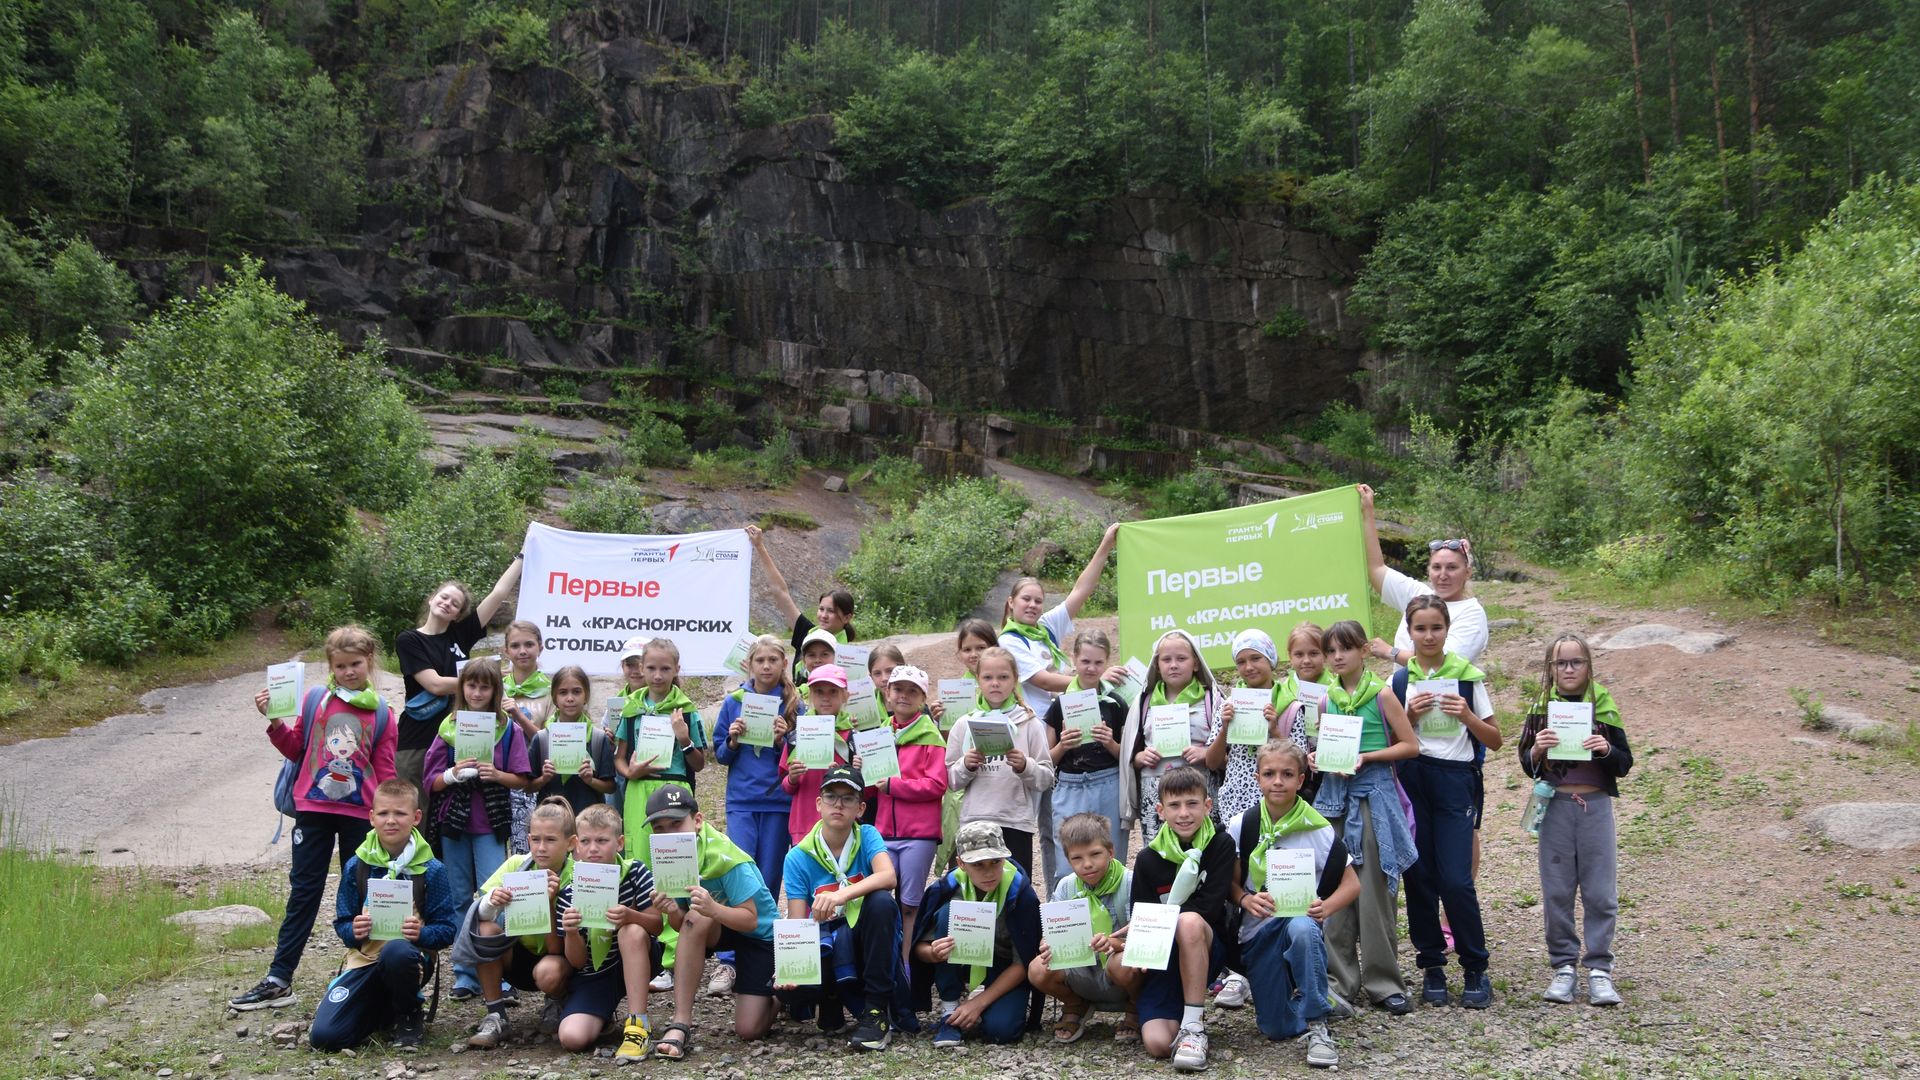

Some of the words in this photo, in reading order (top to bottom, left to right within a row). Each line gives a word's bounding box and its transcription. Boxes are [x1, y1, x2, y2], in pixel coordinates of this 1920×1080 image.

[1226, 533, 1262, 543] ПЕРВЫХ
[1228, 525, 1262, 535] ГРАНТЫ
[548, 572, 660, 602] Первые
[1147, 562, 1262, 598] Первые
[546, 615, 570, 628] НА
[582, 617, 732, 633] «КРАСНОЯРСКИХ
[1150, 614, 1176, 630] НА
[1187, 594, 1349, 625] «КРАСНОЯРСКИХ
